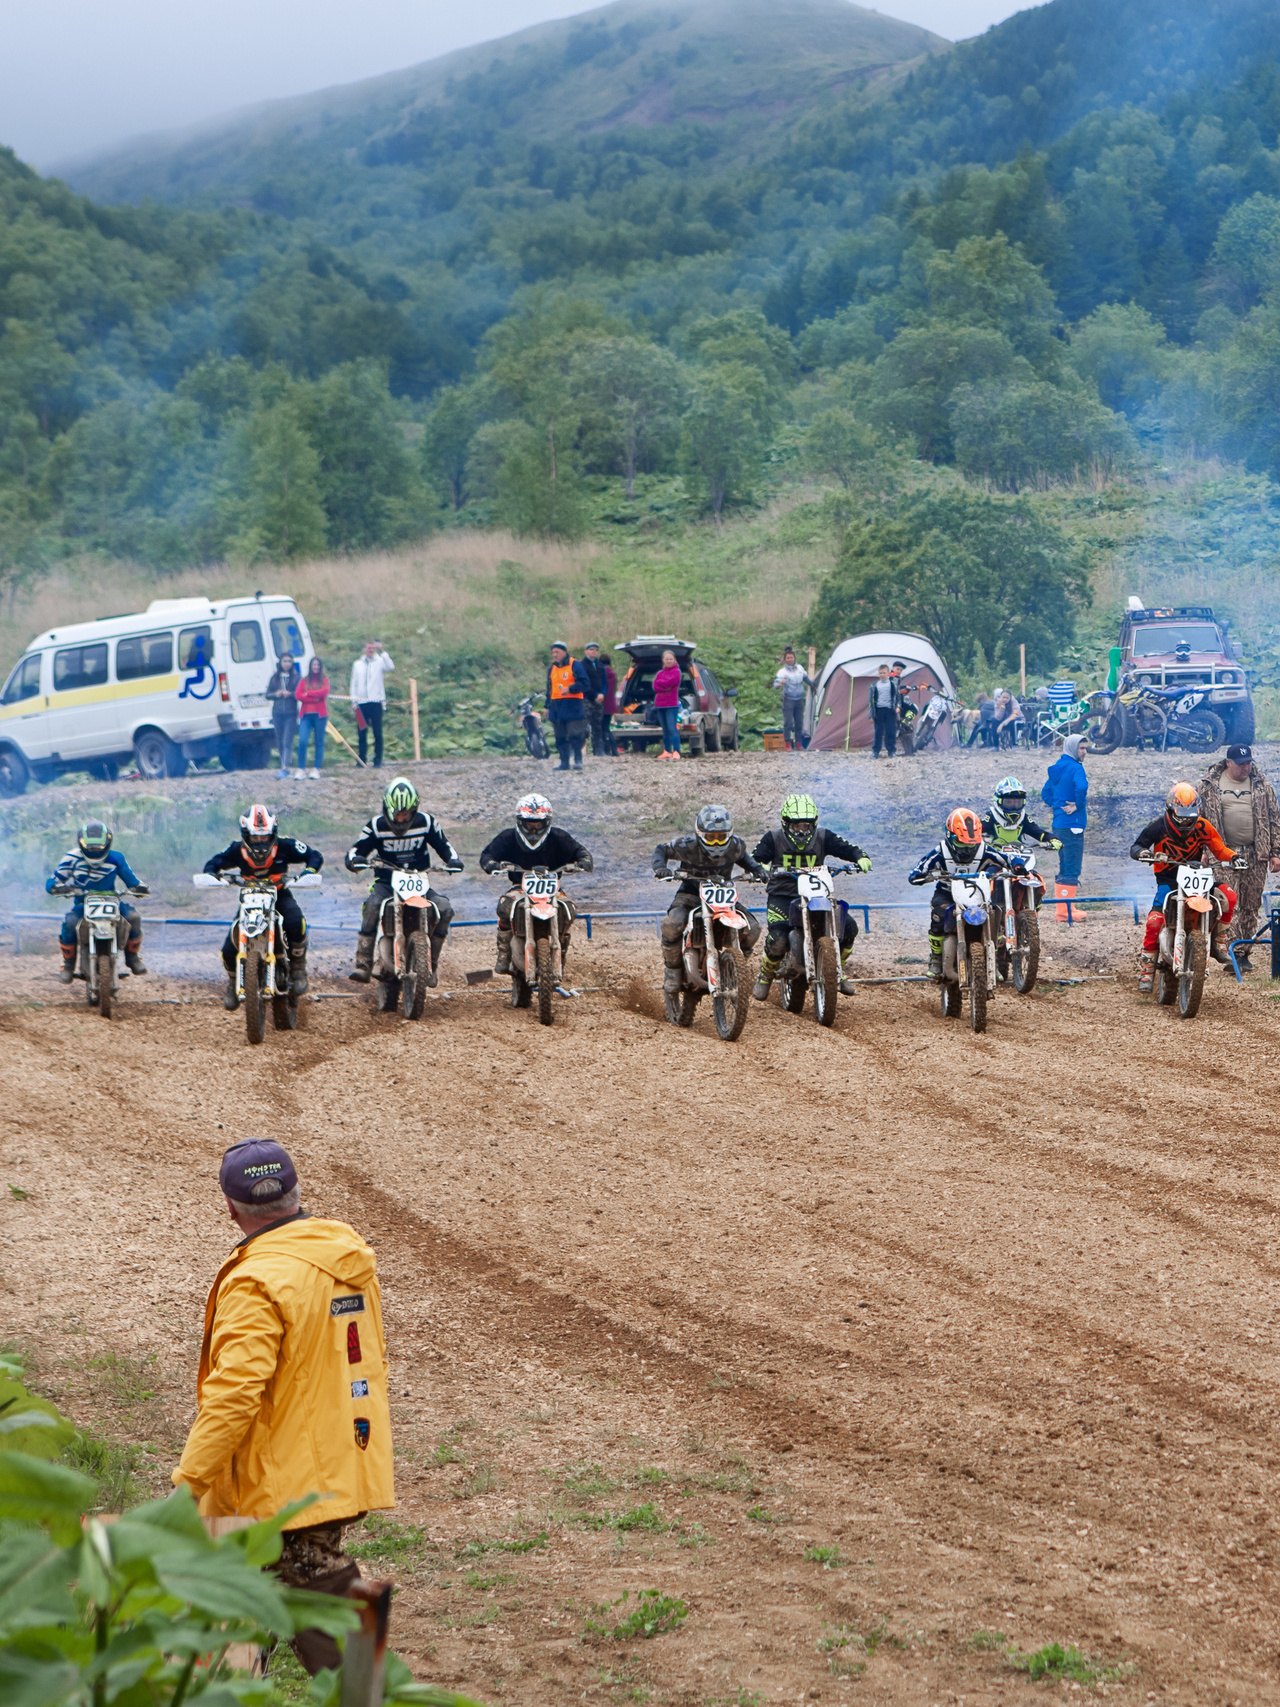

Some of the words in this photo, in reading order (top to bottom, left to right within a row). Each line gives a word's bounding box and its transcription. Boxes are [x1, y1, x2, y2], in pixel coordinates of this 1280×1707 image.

[1183, 696, 1195, 710] 27
[383, 836, 425, 852] SHIFT
[399, 879, 423, 892] 208
[526, 880, 556, 895] 205
[809, 876, 821, 890] 5
[1184, 876, 1209, 890] 207
[705, 889, 735, 904] 202
[88, 904, 116, 915] 70
[244, 1163, 282, 1175] MONSTER
